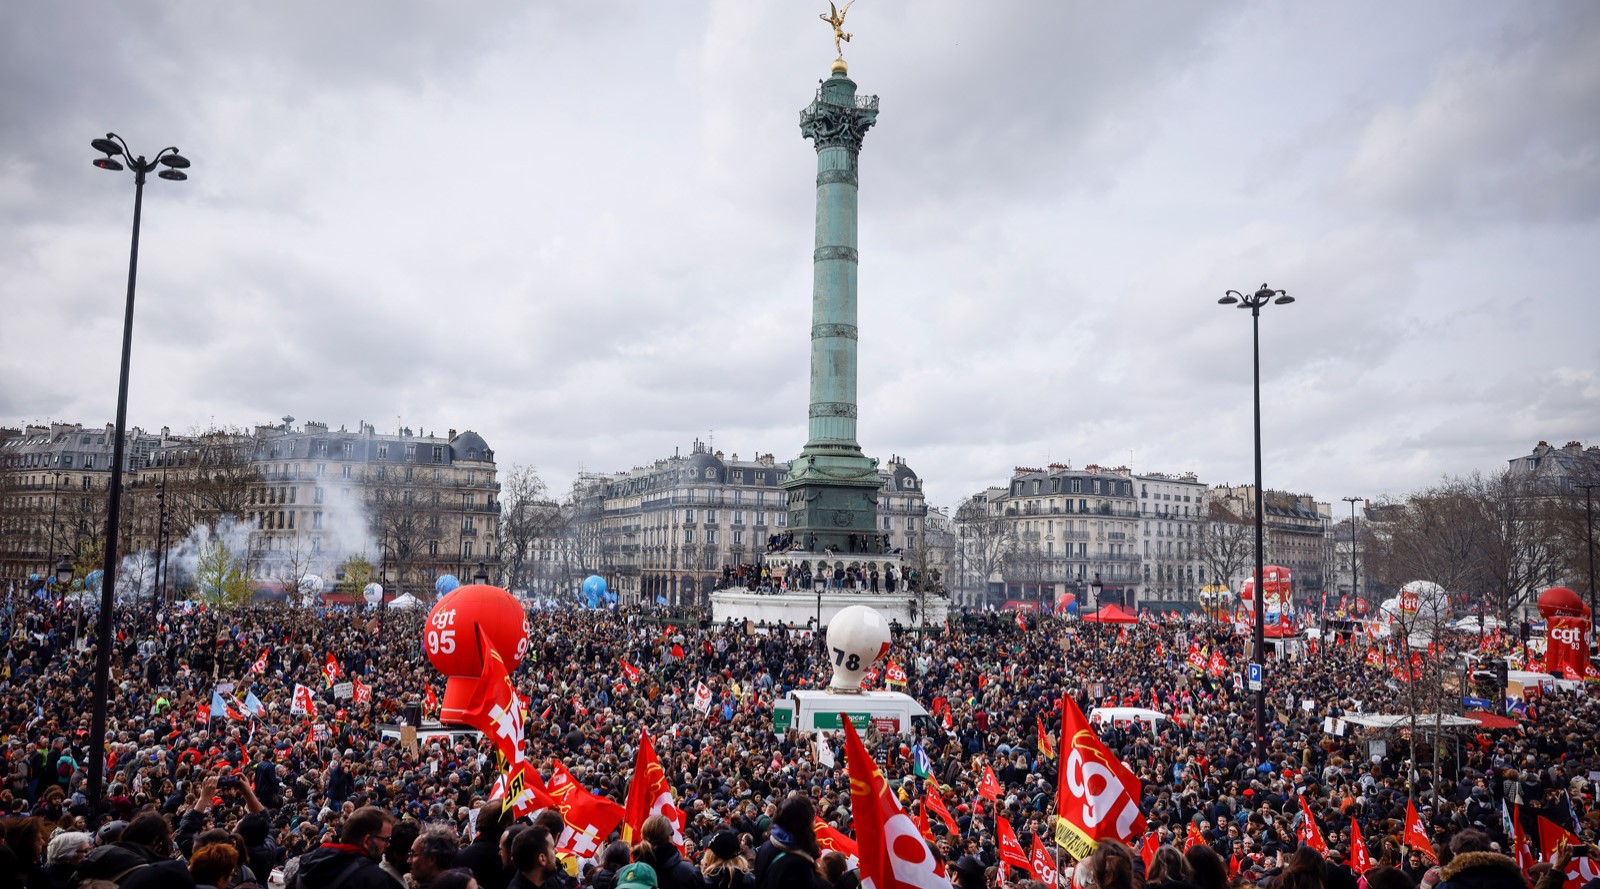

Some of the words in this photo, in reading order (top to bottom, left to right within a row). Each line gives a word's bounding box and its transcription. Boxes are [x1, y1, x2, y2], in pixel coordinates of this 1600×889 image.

[432, 608, 456, 630] cgt
[427, 630, 456, 655] 95
[1551, 627, 1580, 644] cgt
[1571, 642, 1580, 651] 93
[833, 646, 860, 672] 78
[1251, 670, 1258, 679] P
[836, 713, 866, 722] Eopcar
